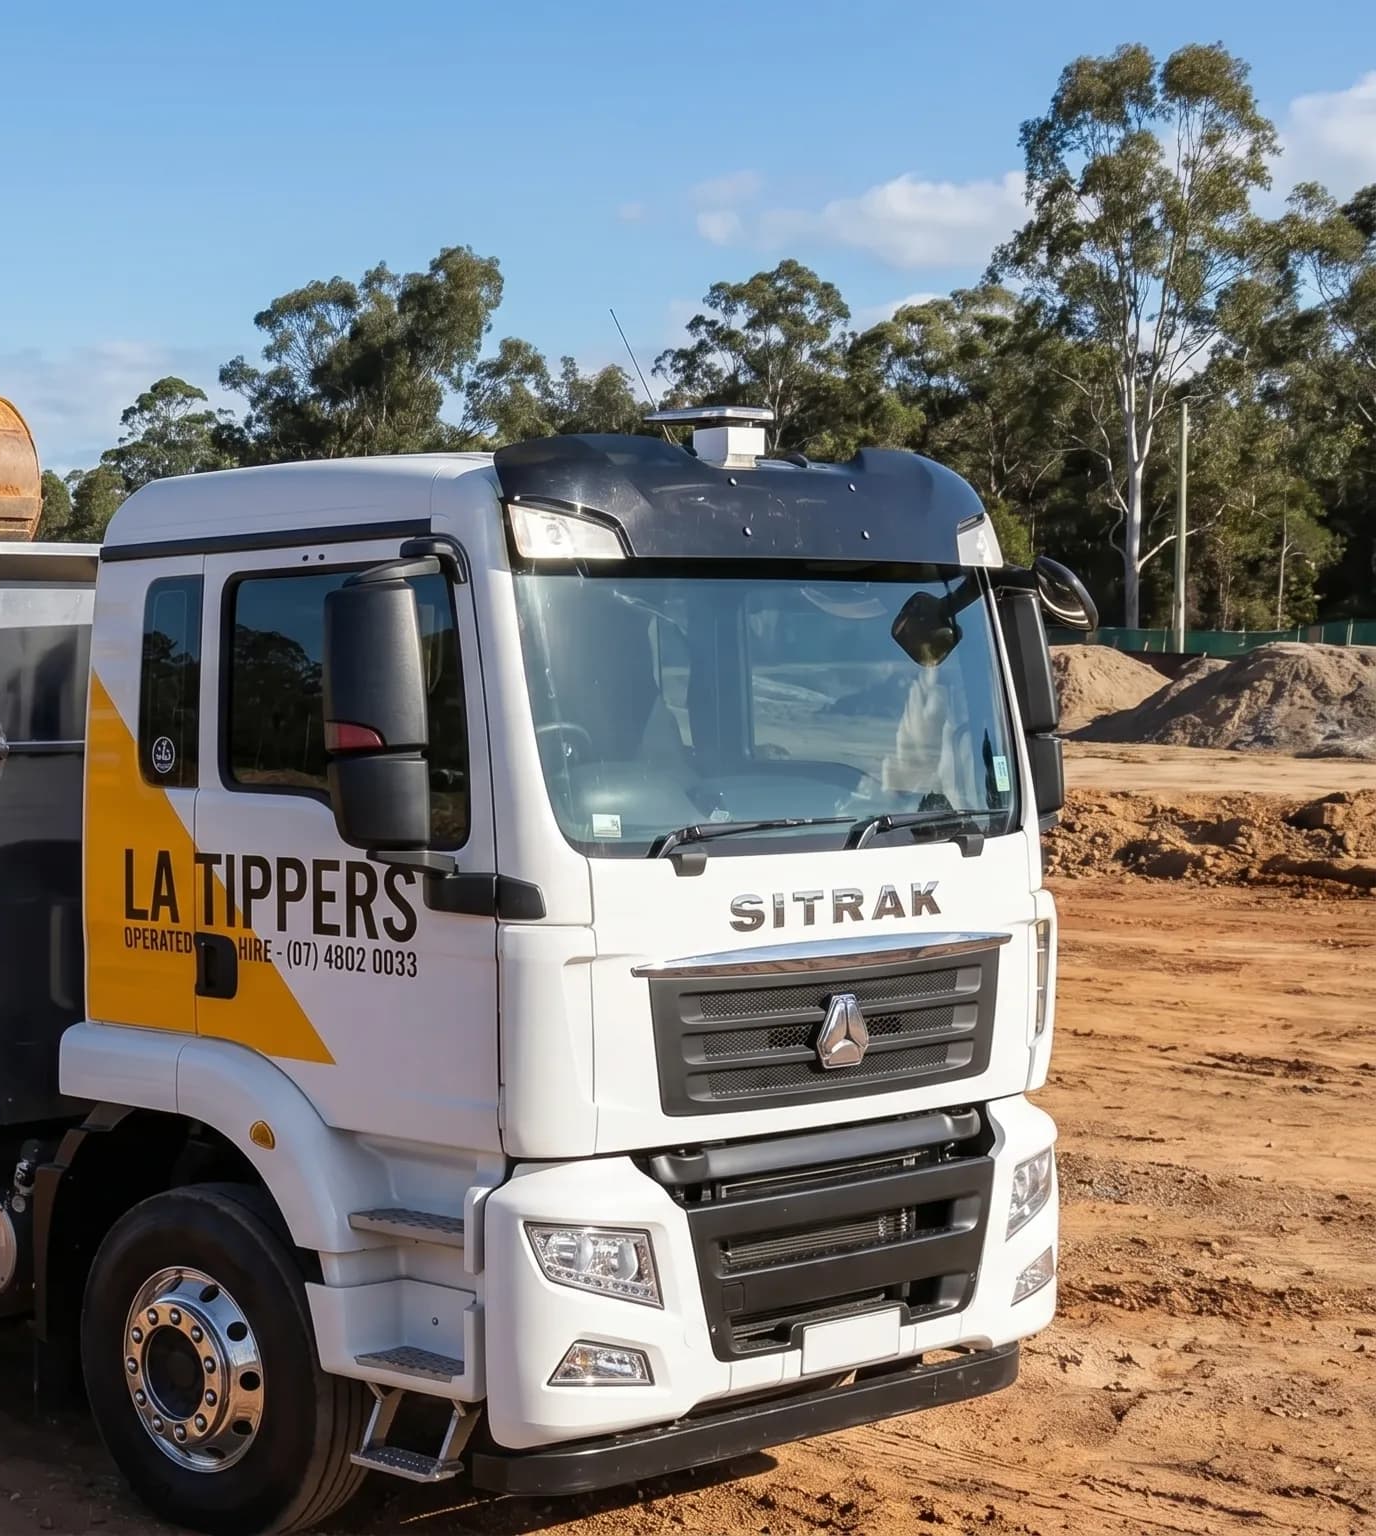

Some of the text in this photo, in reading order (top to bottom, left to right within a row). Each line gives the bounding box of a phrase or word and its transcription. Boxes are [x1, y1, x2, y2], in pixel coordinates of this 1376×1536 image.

[124, 848, 417, 943] LA TIPPERS
[729, 880, 942, 933] SITRAK
[124, 926, 192, 954] OPERATED
[238, 937, 272, 963] HIRE
[287, 940, 318, 971] (07)
[324, 943, 366, 973] 4802
[373, 948, 417, 978] 0033
